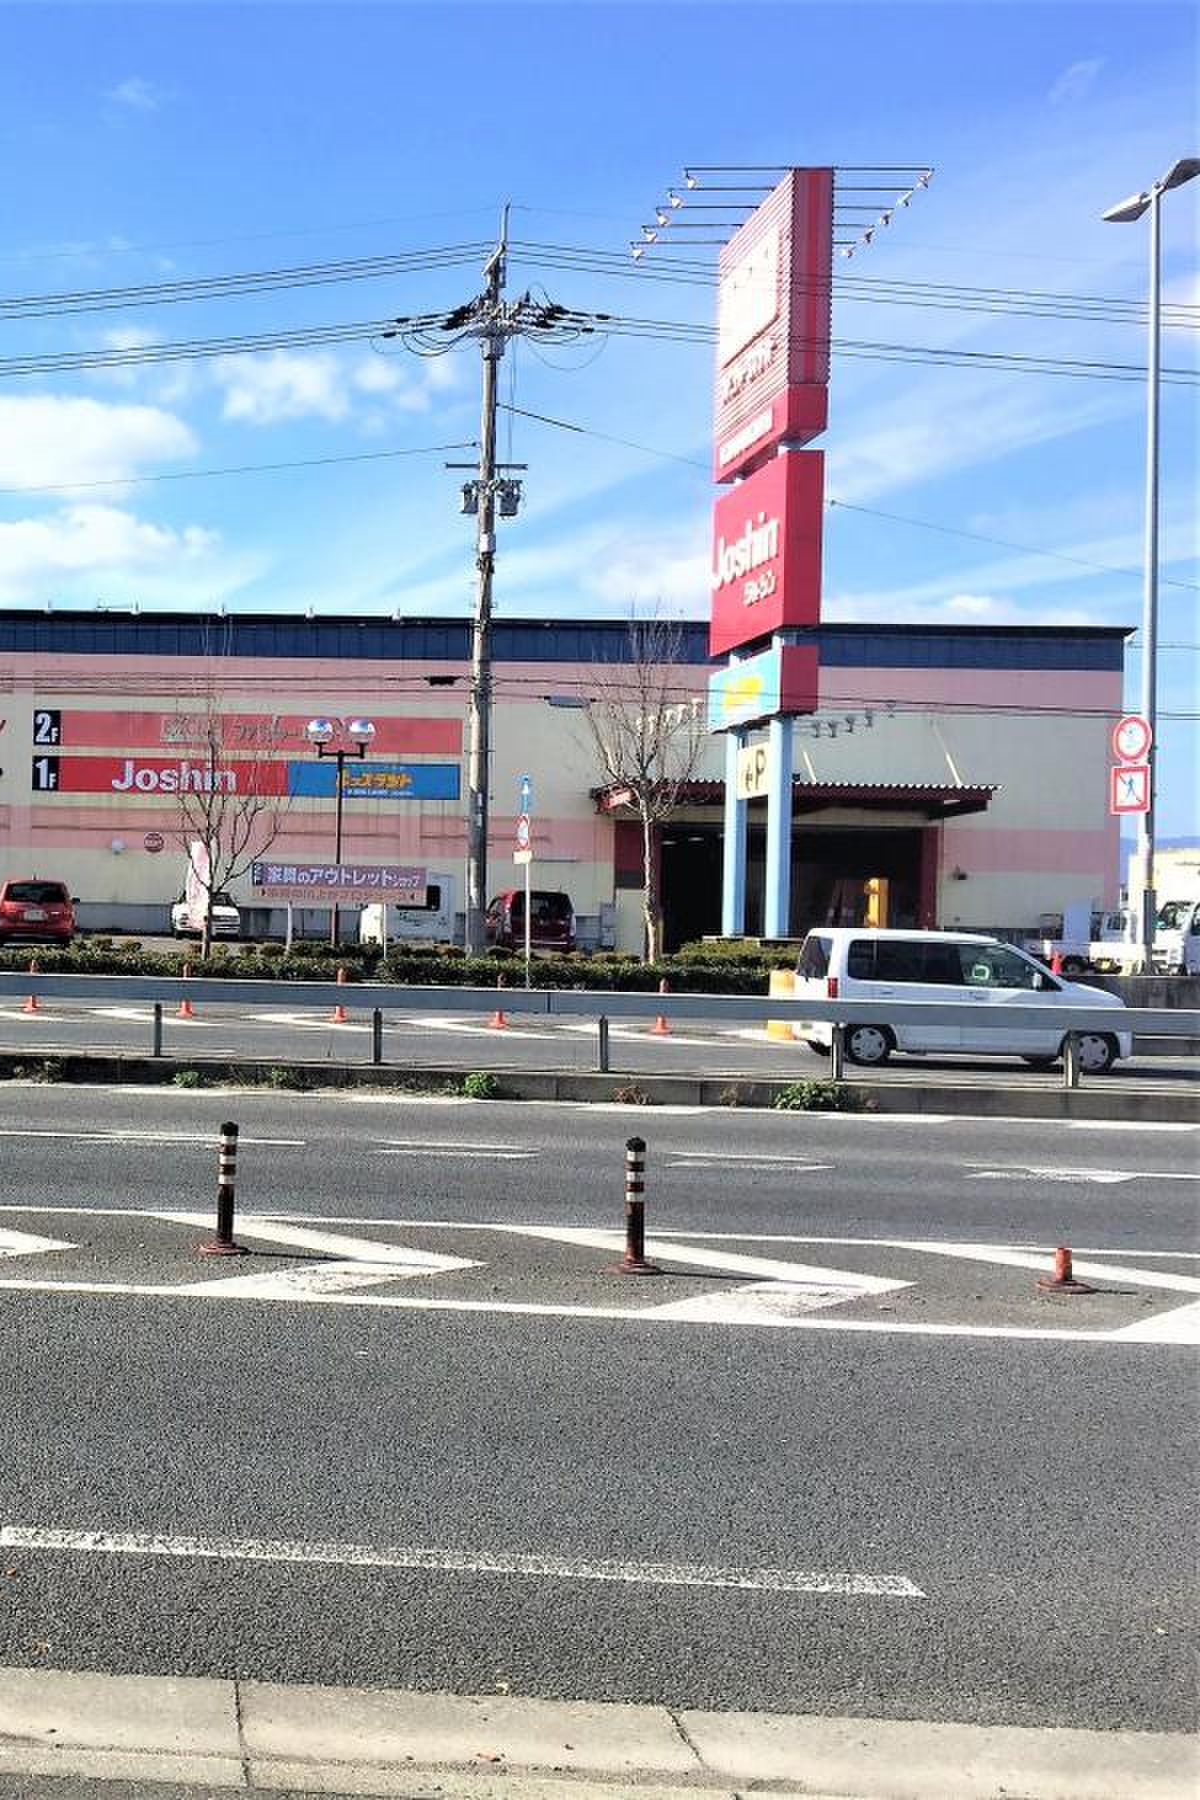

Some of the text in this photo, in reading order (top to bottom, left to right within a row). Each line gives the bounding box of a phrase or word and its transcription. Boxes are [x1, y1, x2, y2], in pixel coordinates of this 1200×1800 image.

[709, 511, 779, 590] Joshin
[34, 711, 59, 744] 2F
[34, 757, 58, 790] 1F
[111, 761, 238, 793] Joshin
